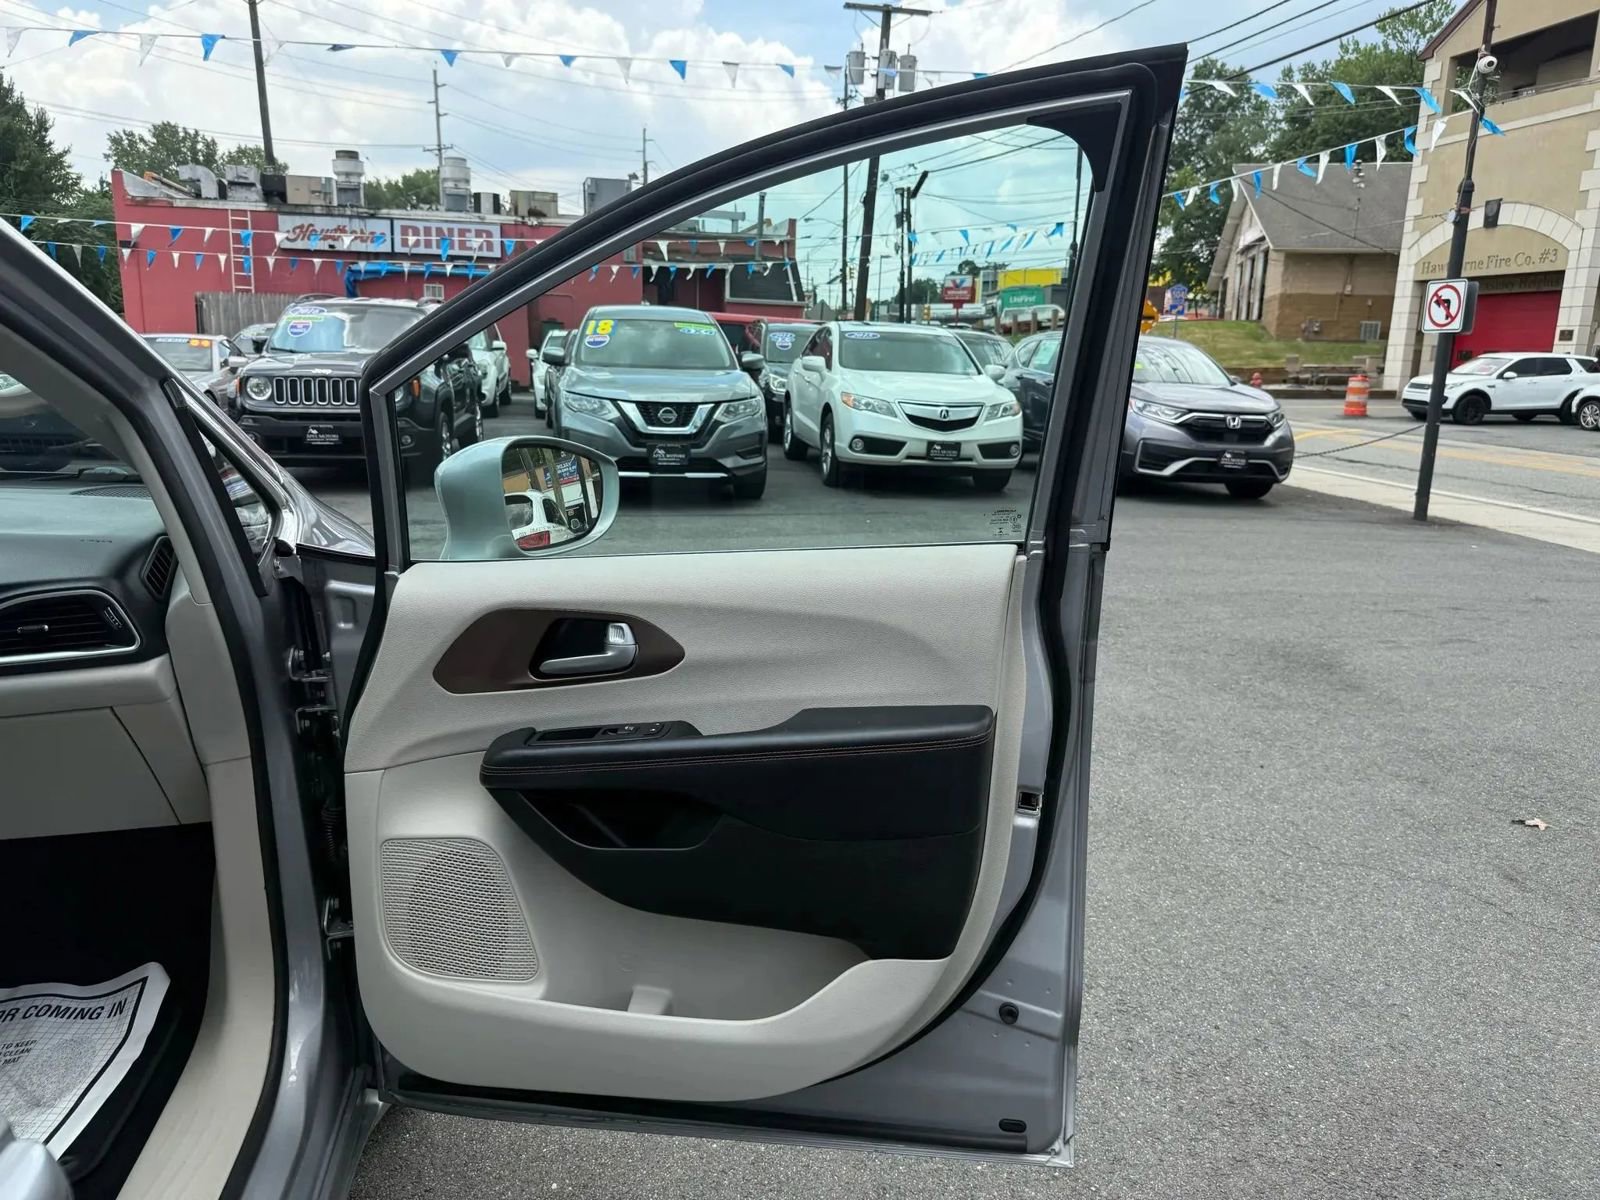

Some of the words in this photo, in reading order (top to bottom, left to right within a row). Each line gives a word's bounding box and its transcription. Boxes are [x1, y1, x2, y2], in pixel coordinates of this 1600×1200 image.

[400, 224, 494, 253] DINER
[1421, 260, 1484, 275] Hawrne
[1485, 254, 1511, 270] Fire
[1514, 251, 1536, 268] Co.
[1538, 247, 1559, 265] #3
[1009, 295, 1037, 304] UniFirst
[586, 320, 614, 335] 18
[22, 1004, 105, 1020] COMING
[107, 998, 127, 1018] IN
